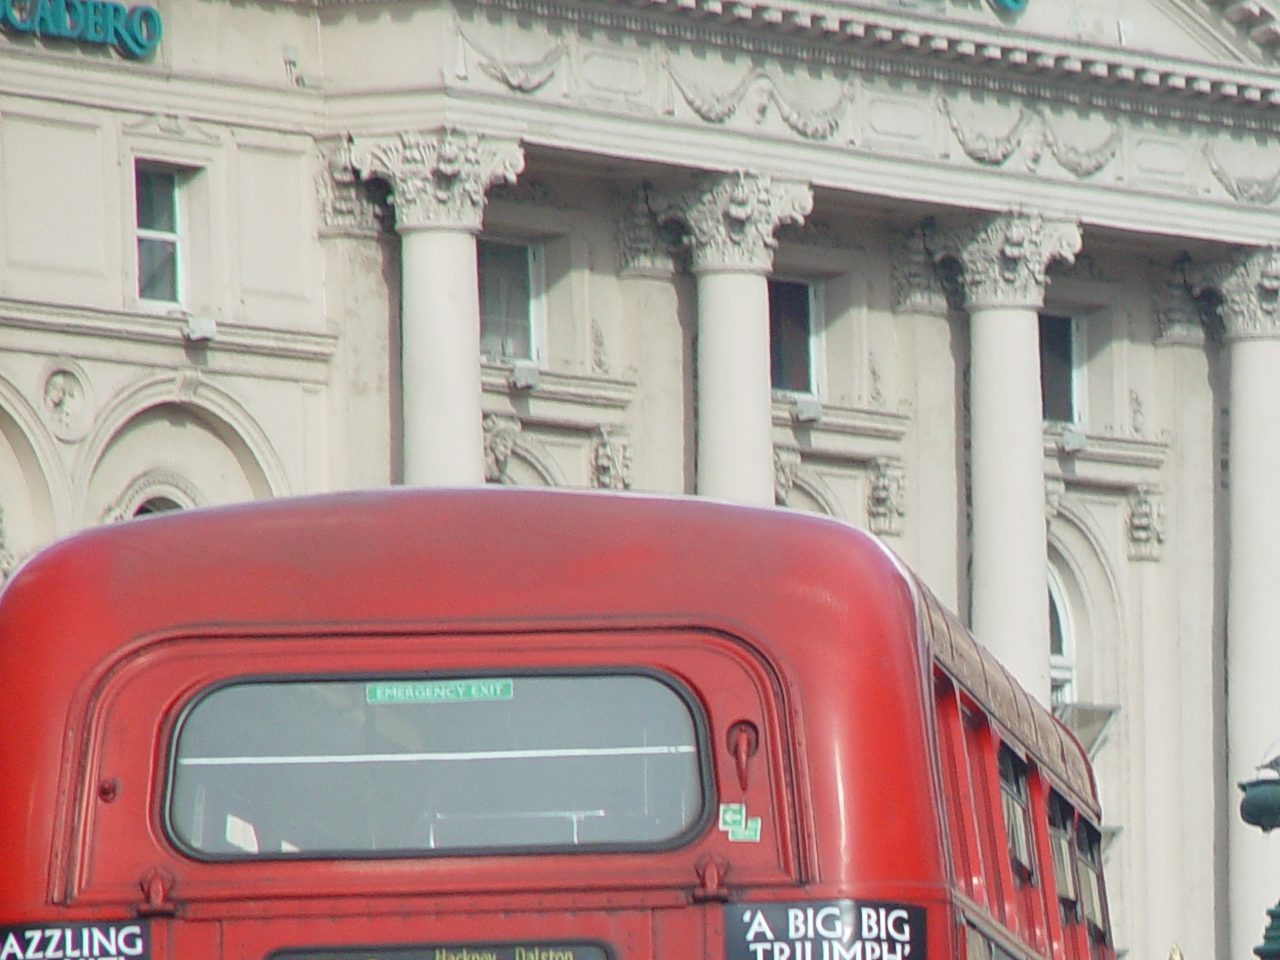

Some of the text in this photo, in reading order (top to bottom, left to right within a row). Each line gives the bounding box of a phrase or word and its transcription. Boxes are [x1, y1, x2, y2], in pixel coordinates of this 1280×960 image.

[0, 0, 163, 57] CADERO
[376, 681, 503, 699] EMERGENCY EXIT
[788, 906, 852, 943] BIG,
[860, 906, 911, 942] BIG
